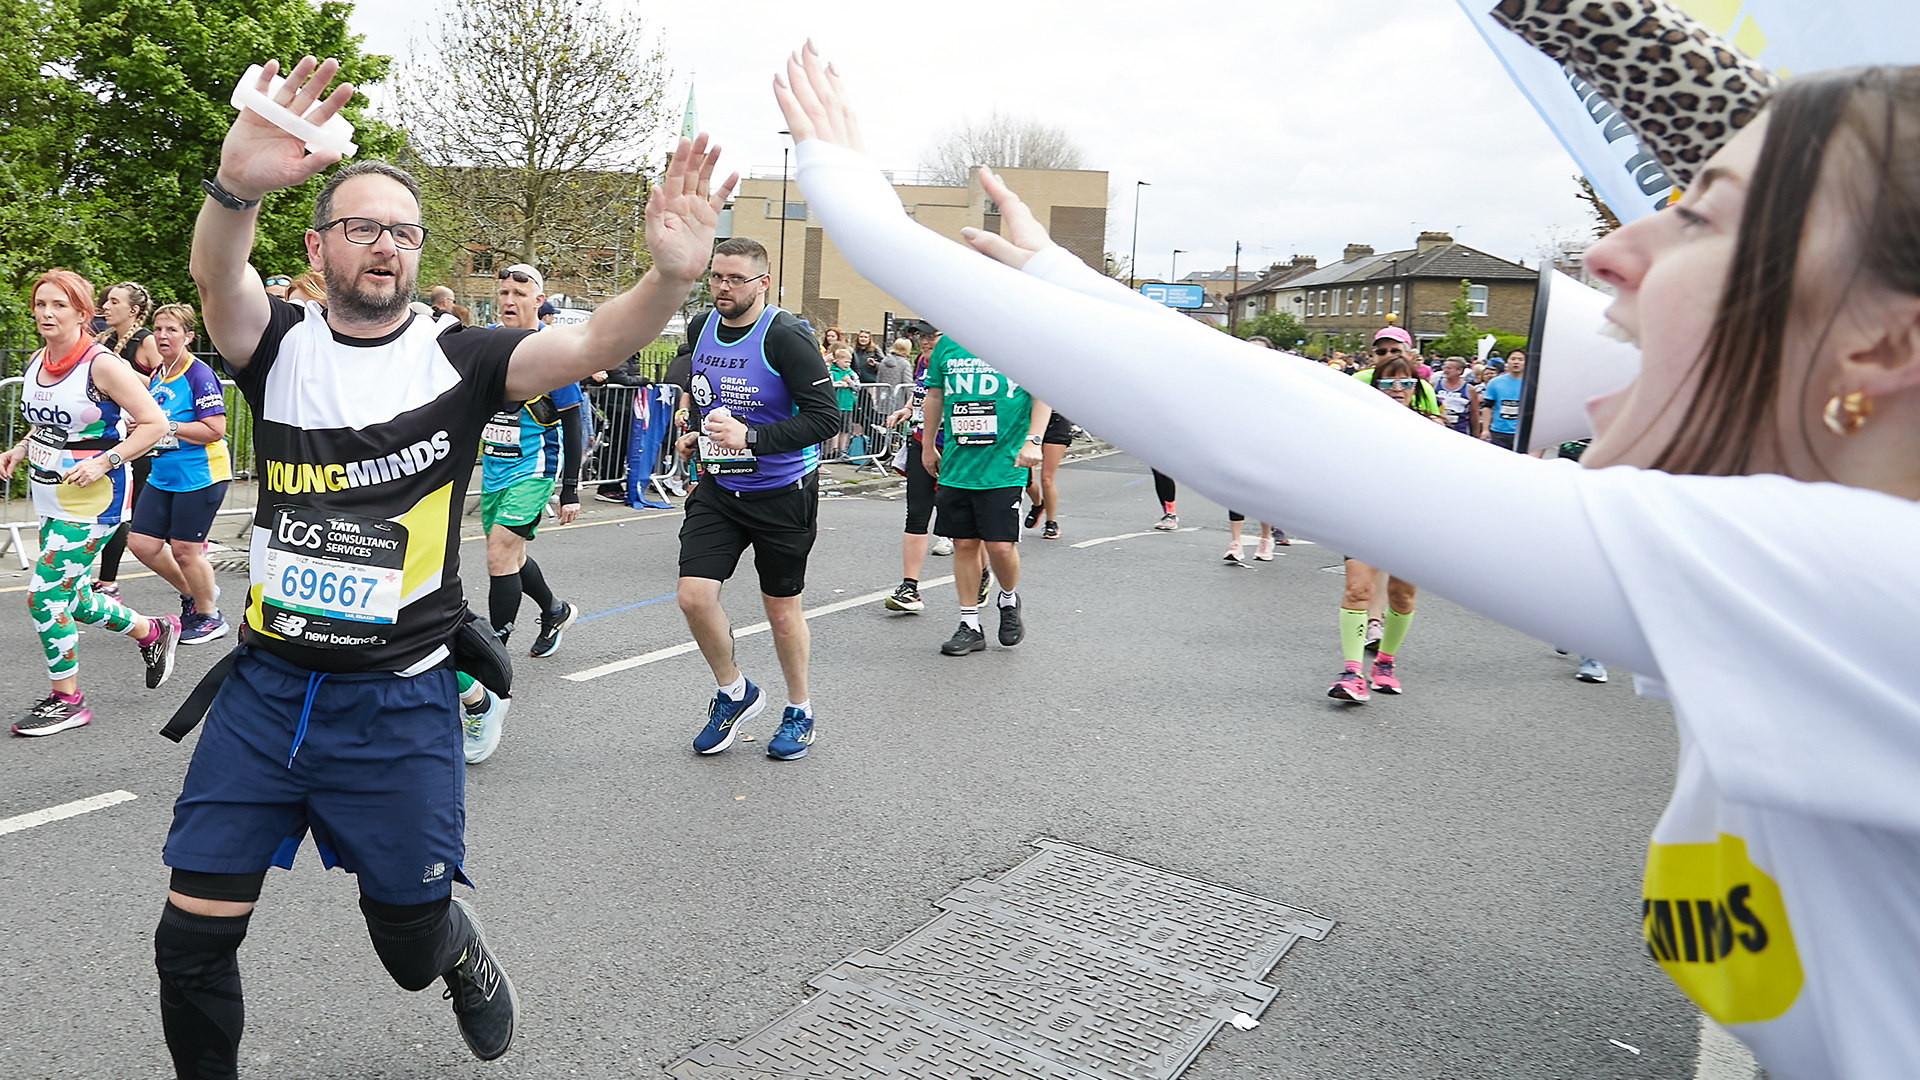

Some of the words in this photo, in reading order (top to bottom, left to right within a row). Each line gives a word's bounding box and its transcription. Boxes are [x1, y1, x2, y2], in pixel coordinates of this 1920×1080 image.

[697, 353, 748, 369] ASHLEY
[720, 377, 748, 386] GREAT
[720, 384, 760, 394] ORMOND
[720, 391, 751, 400] STREET
[33, 391, 55, 402] KELLY
[720, 398, 764, 407] HOSPITAL
[957, 419, 988, 431] 30951
[485, 427, 512, 443] 27178
[266, 430, 451, 495] YOUNGMINDS
[277, 511, 324, 549] tcs
[330, 520, 361, 534] TATA
[327, 531, 399, 551] CONSULTANCY
[325, 542, 372, 559] SERVICES
[281, 564, 379, 609] 69667
[305, 631, 330, 643] new
